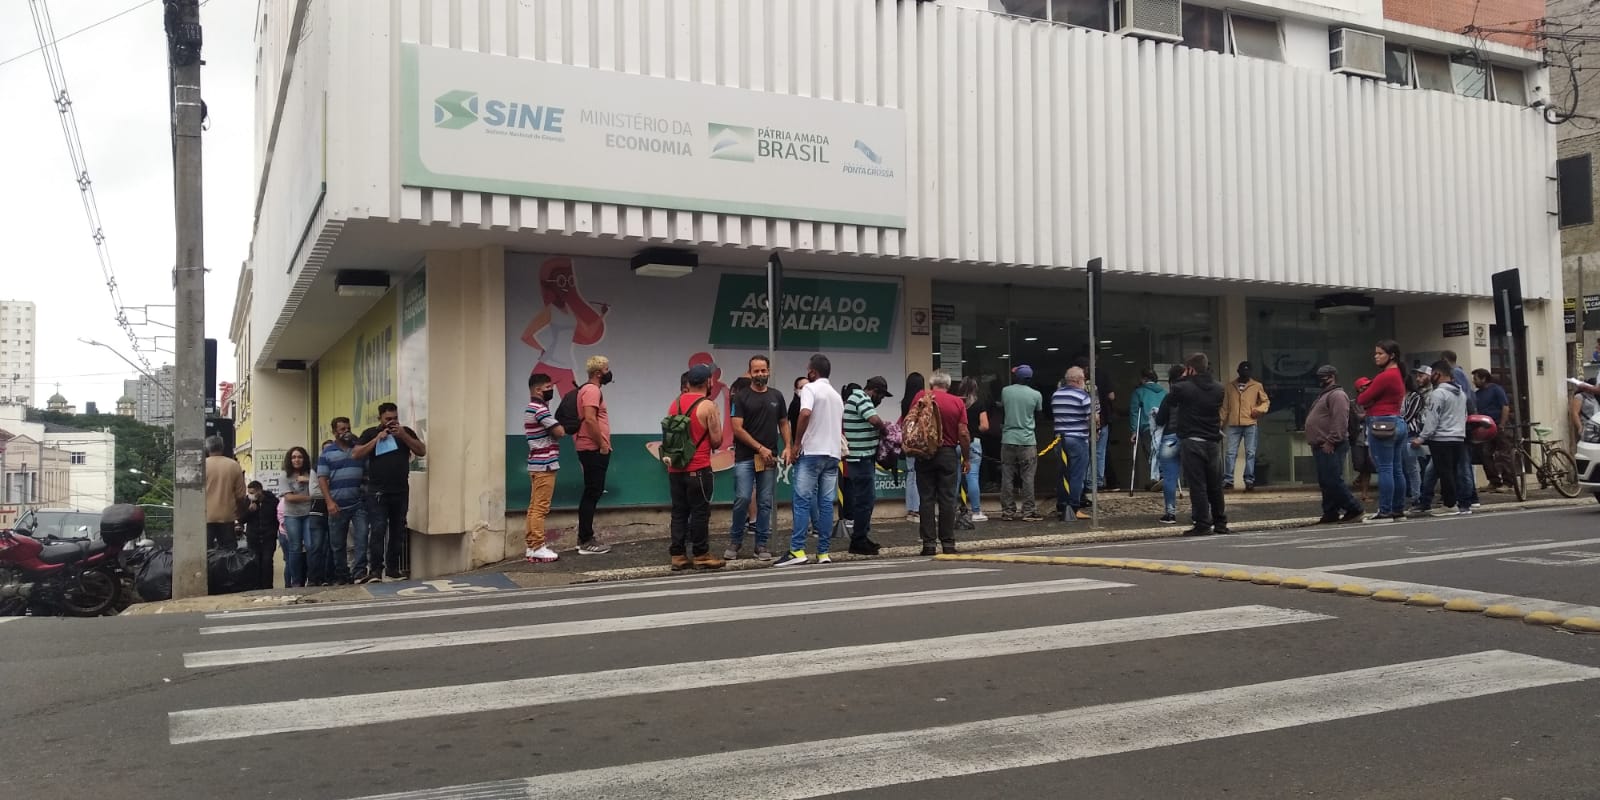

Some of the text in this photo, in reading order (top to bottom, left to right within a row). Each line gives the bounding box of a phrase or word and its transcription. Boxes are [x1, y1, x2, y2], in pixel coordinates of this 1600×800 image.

[580, 109, 693, 136] MINISTÉRIO DA
[605, 133, 693, 157] ECONOMIA
[758, 127, 830, 145] PÁTRIA AMADA
[758, 139, 830, 164] BRASIL
[842, 165, 895, 178] PONTA GROSSA
[837, 297, 866, 314] DO
